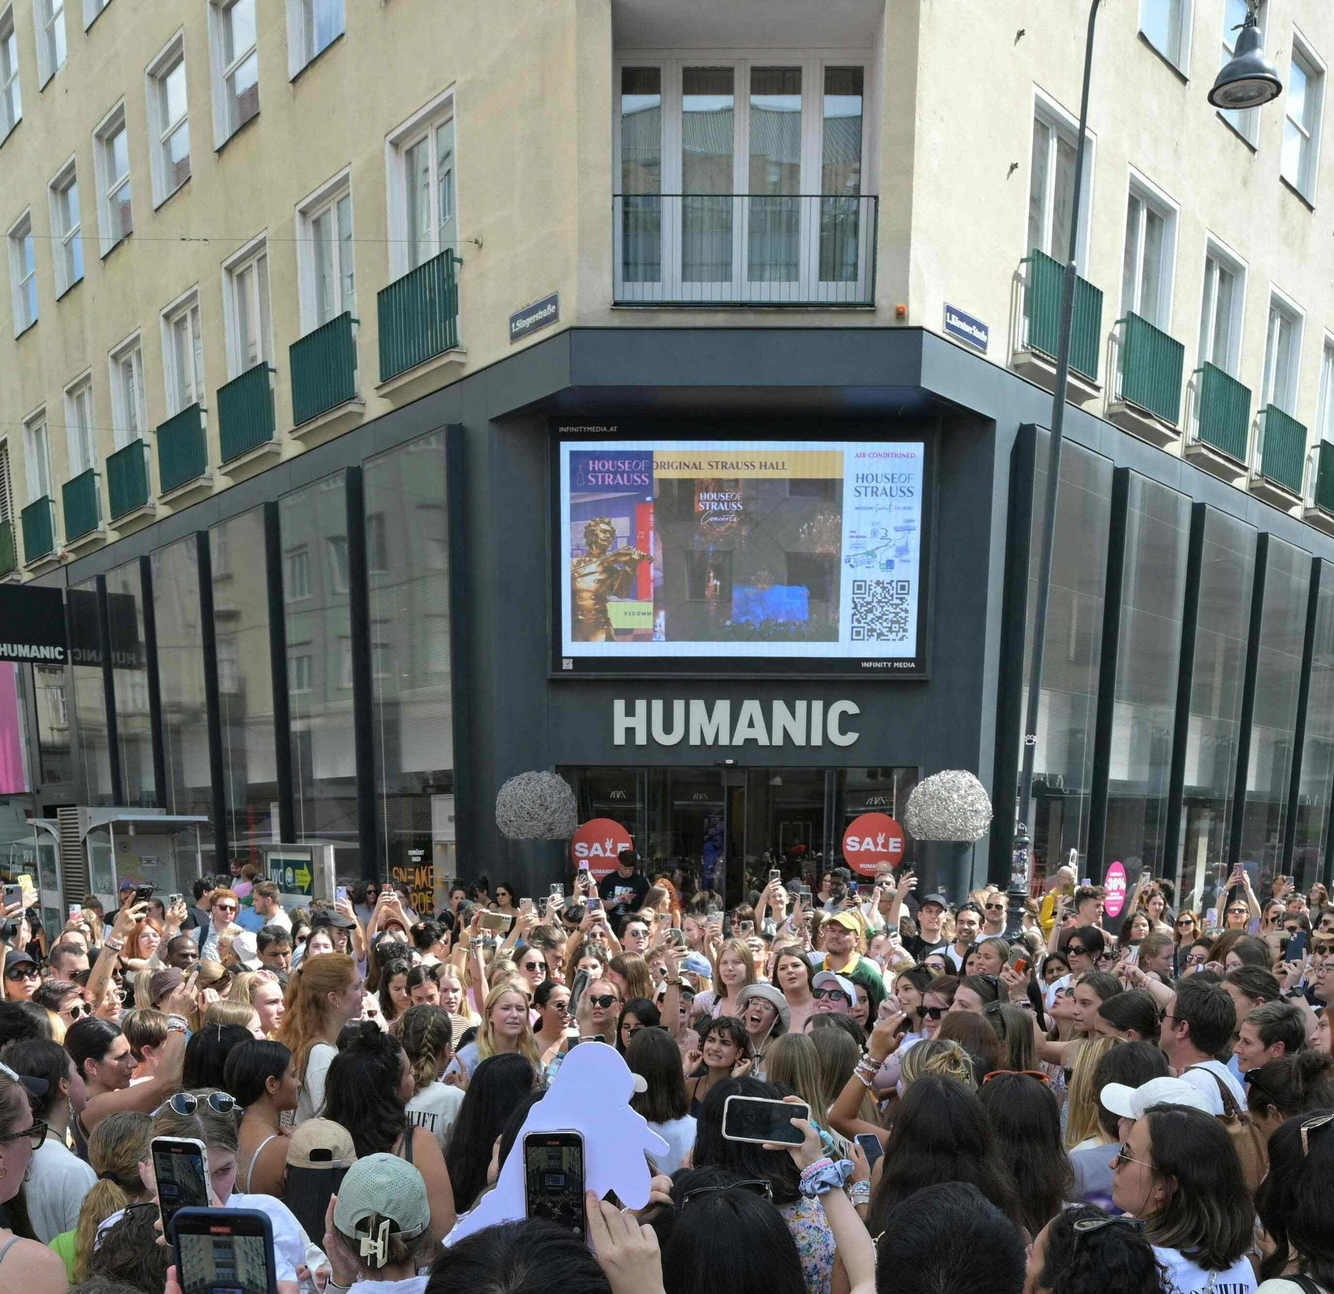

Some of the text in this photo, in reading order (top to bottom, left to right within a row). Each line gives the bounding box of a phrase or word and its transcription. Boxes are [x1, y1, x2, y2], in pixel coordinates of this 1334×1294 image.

[708, 460, 756, 471] STRAUSS
[759, 460, 788, 471] HALL
[587, 473, 650, 486] STRAUSS
[854, 485, 915, 498] STRAUSS
[699, 501, 744, 511] STRAUSS
[613, 699, 861, 747] HUMANIC
[575, 838, 630, 858] SALE
[846, 833, 902, 853] SALE
[406, 1110, 439, 1133] WIFT
